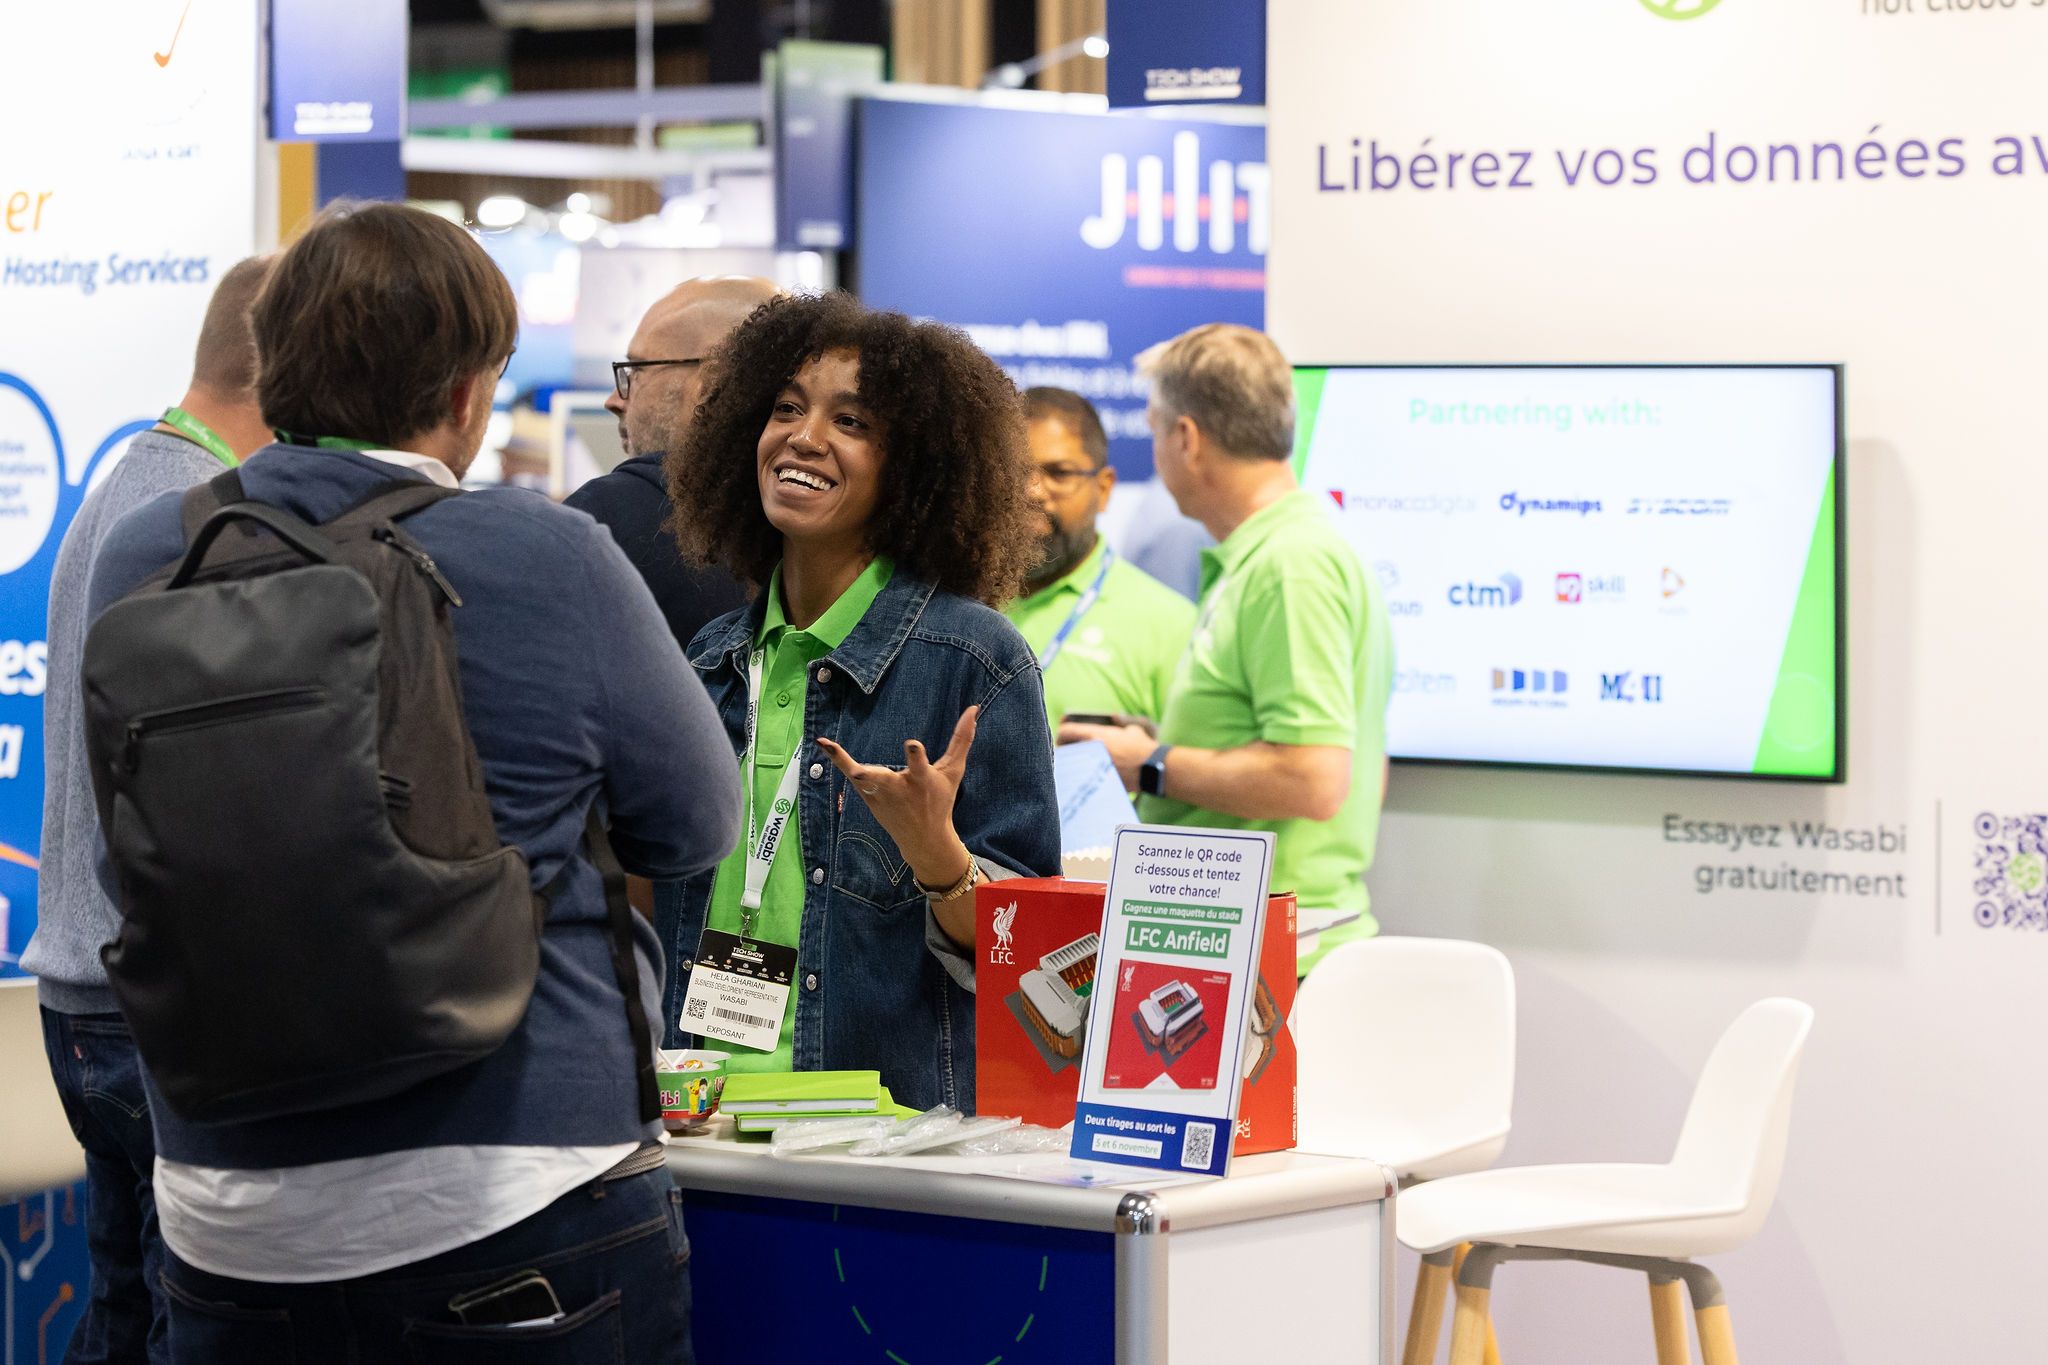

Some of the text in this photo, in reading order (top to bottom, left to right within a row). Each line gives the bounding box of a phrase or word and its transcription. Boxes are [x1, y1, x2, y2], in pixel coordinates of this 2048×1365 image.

[1318, 136, 1534, 192] Libérez
[1556, 147, 1659, 187] vos
[1682, 124, 1967, 183] données
[3, 251, 210, 295] Hosting Services
[1409, 397, 1662, 432] Partnering with:
[1448, 581, 1504, 607] ctm
[761, 817, 784, 865] wasabi
[1662, 813, 1908, 854] Essayez Wasabi
[1137, 844, 1243, 863] Scannez le QR code
[1134, 862, 1241, 882] ci-dessous et tentez
[1693, 861, 1908, 899] gratuitement
[1149, 884, 1222, 899] votre chance!
[1124, 902, 1240, 921] Gagnez une maquette du stade
[1128, 926, 1228, 954] LFC Anfield
[732, 946, 747, 956] TECH
[747, 950, 765, 960] SHOW
[694, 977, 779, 1004] BUSINESS DEVELOPMENT REPRESENTATIVE
[710, 971, 730, 984] HELA
[730, 976, 767, 991] GHARIANI
[719, 993, 748, 1007] WASABI
[706, 1025, 747, 1041] EXPOSANT
[1084, 1114, 1177, 1135] Deux tirages au sort les
[1095, 1137, 1159, 1155] 5 et 6 novembre
